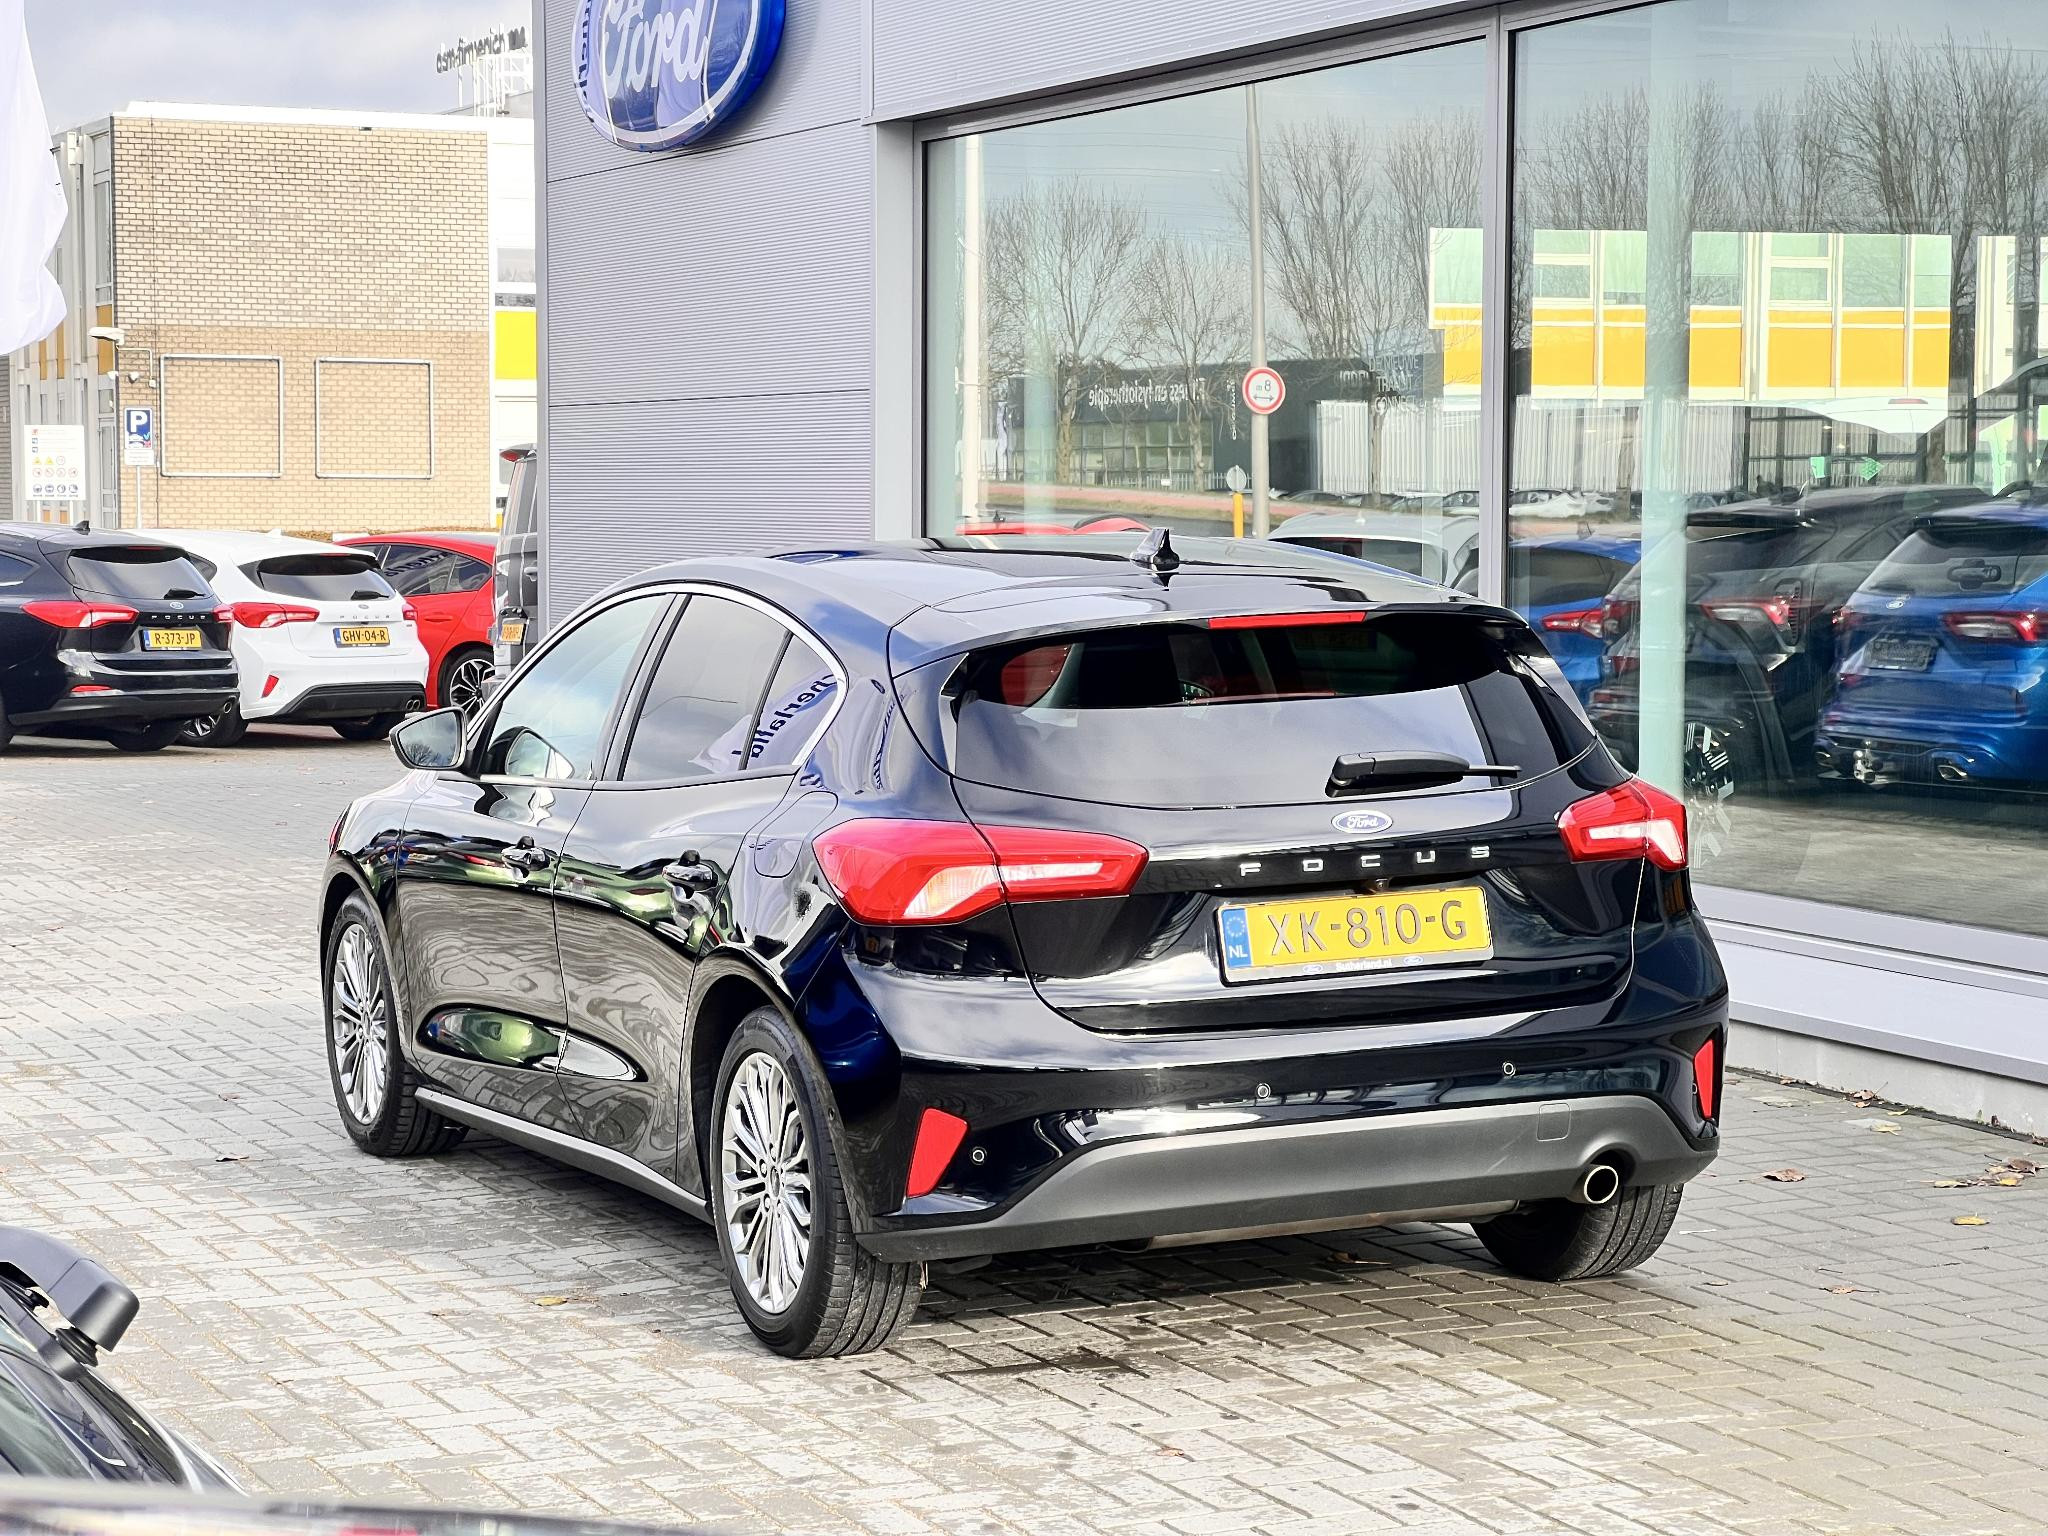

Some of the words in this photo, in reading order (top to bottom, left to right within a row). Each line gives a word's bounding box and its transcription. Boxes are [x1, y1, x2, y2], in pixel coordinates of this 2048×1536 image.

[603, 0, 709, 99] Ford
[1376, 369, 1413, 393] TRANSIT
[130, 410, 148, 433] P
[154, 632, 196, 645] R-373-JP
[342, 629, 387, 642] GHV-04-R
[1239, 845, 1490, 877] FOCUS
[1229, 944, 1249, 959] NL
[1268, 899, 1468, 956] XK-810-G
